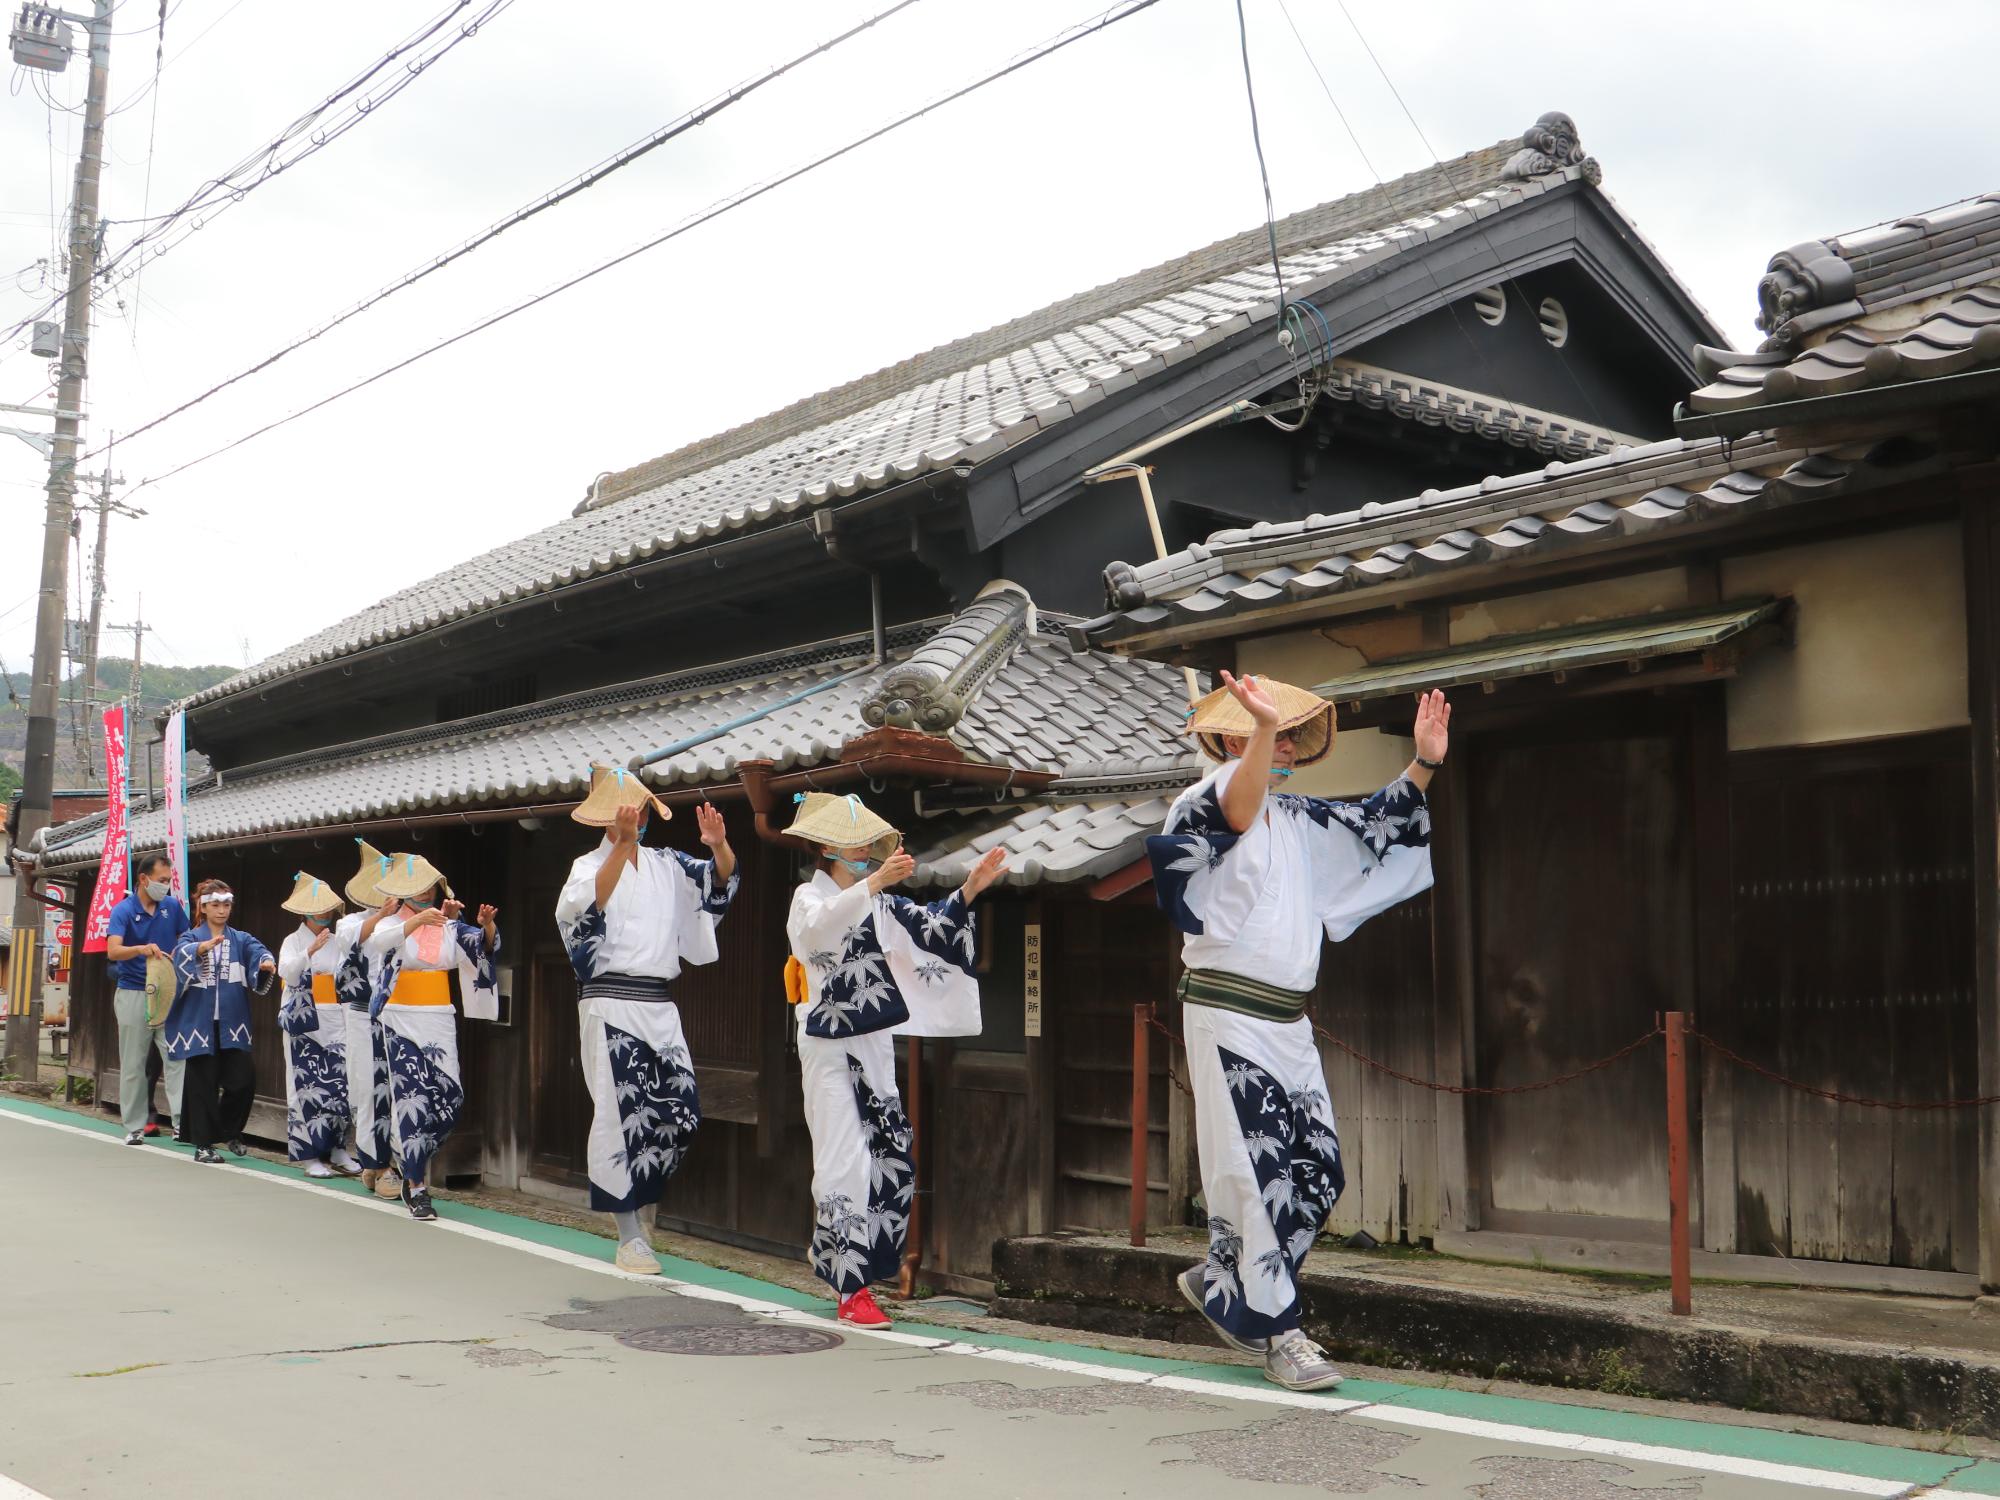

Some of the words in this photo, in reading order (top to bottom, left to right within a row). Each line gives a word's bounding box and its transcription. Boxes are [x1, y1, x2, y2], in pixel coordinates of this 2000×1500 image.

[58, 928, 72, 938] 消火
[1027, 936, 1039, 1013] 防犯連絡所
